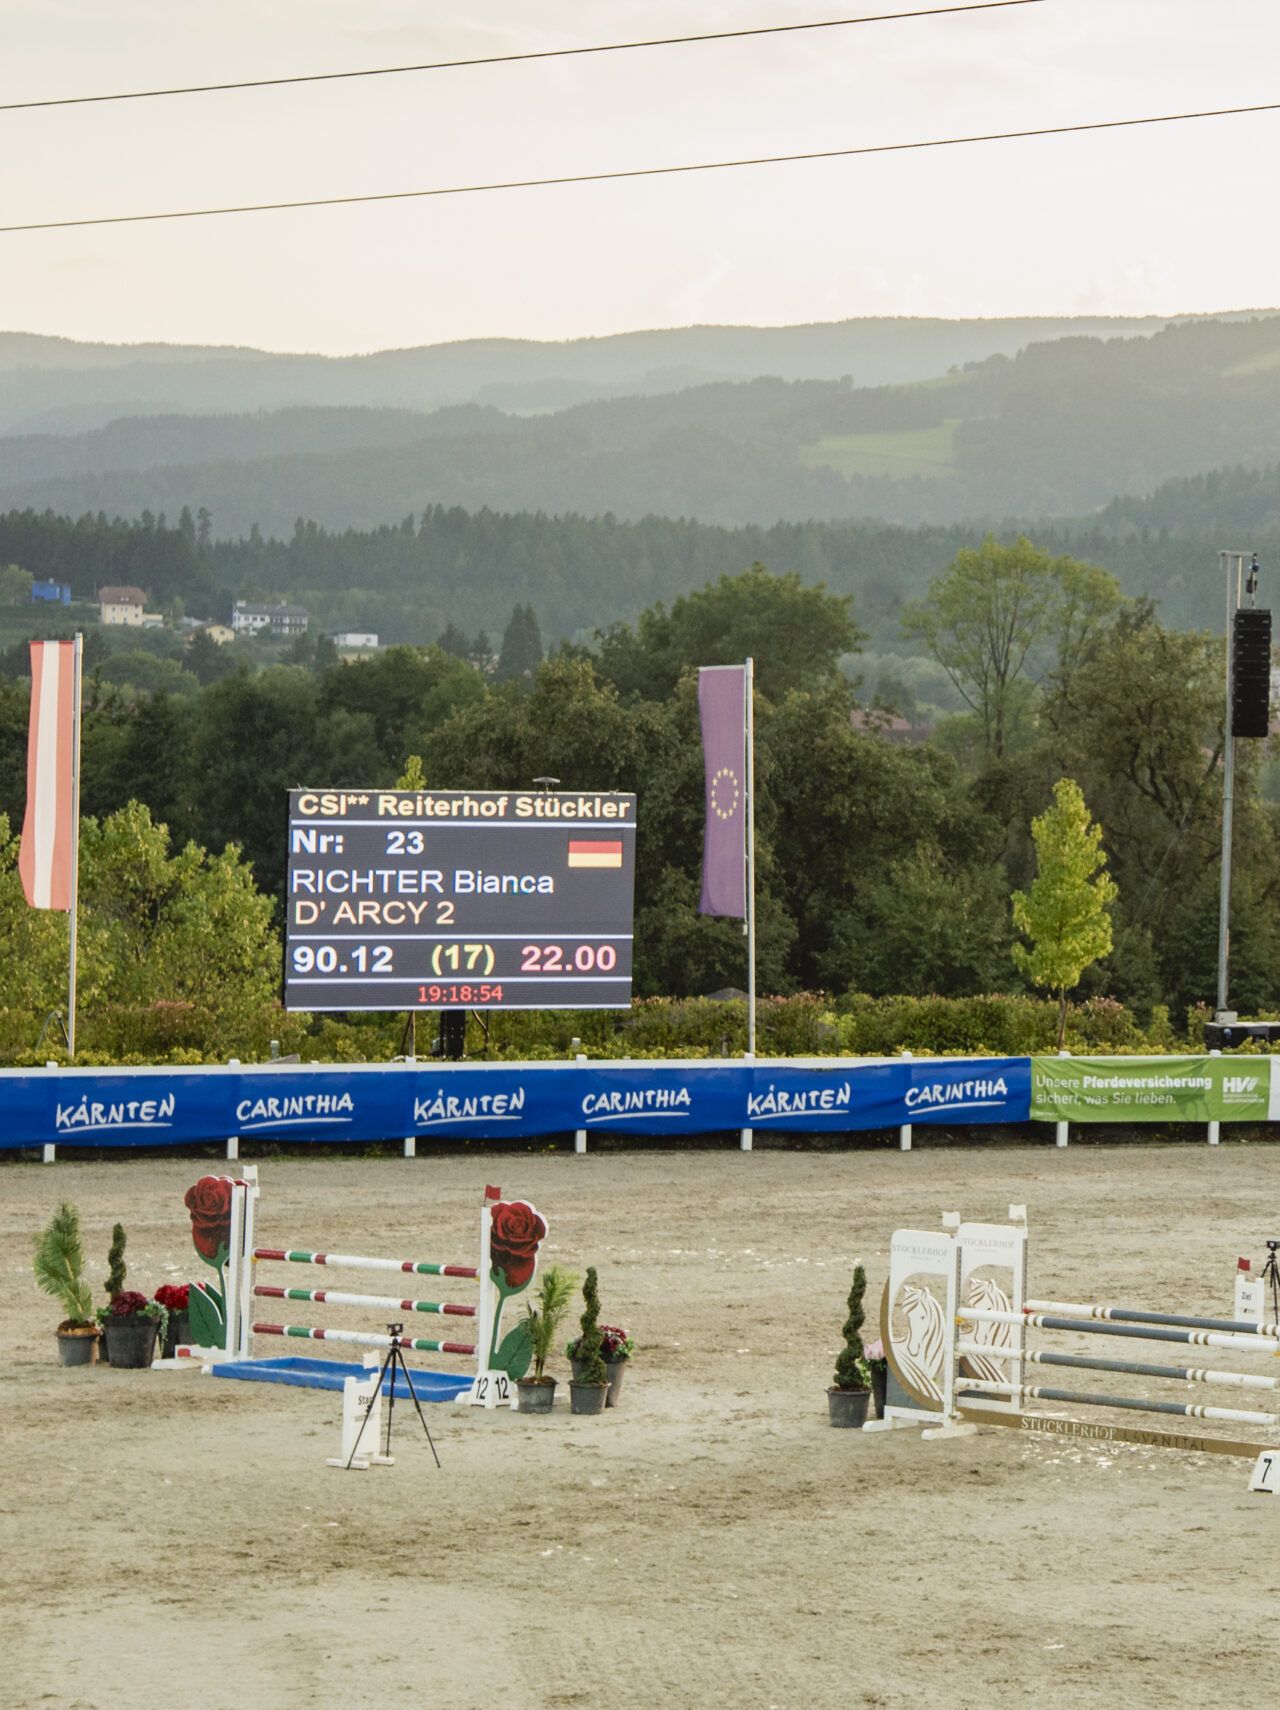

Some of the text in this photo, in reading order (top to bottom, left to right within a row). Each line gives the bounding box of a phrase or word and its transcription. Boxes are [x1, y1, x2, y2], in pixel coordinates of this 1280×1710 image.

[379, 796, 508, 817] Reiterhof
[515, 796, 631, 818] Stückler
[292, 829, 424, 855] Nr: 23
[292, 869, 554, 893] RICHTER Bianca
[436, 901, 455, 925] 2
[293, 944, 616, 976] 90.12 (17) 22.00
[418, 985, 503, 1002] 19:18:54
[905, 1077, 1008, 1107] CARINTHIA
[1036, 1075, 1212, 1090] Unsere Pferdeversicherung
[236, 1092, 354, 1121] CARINTHIA
[582, 1088, 691, 1114] CARINTHIA
[1085, 1095, 1108, 1104] was
[1112, 1092, 1131, 1104] Sie
[1135, 1092, 1177, 1104] lieben.
[477, 1376, 489, 1400] 12
[495, 1377, 509, 1399] 12
[1021, 1416, 1117, 1440] STÜCKLERHOF
[1262, 1458, 1272, 1483] 7
